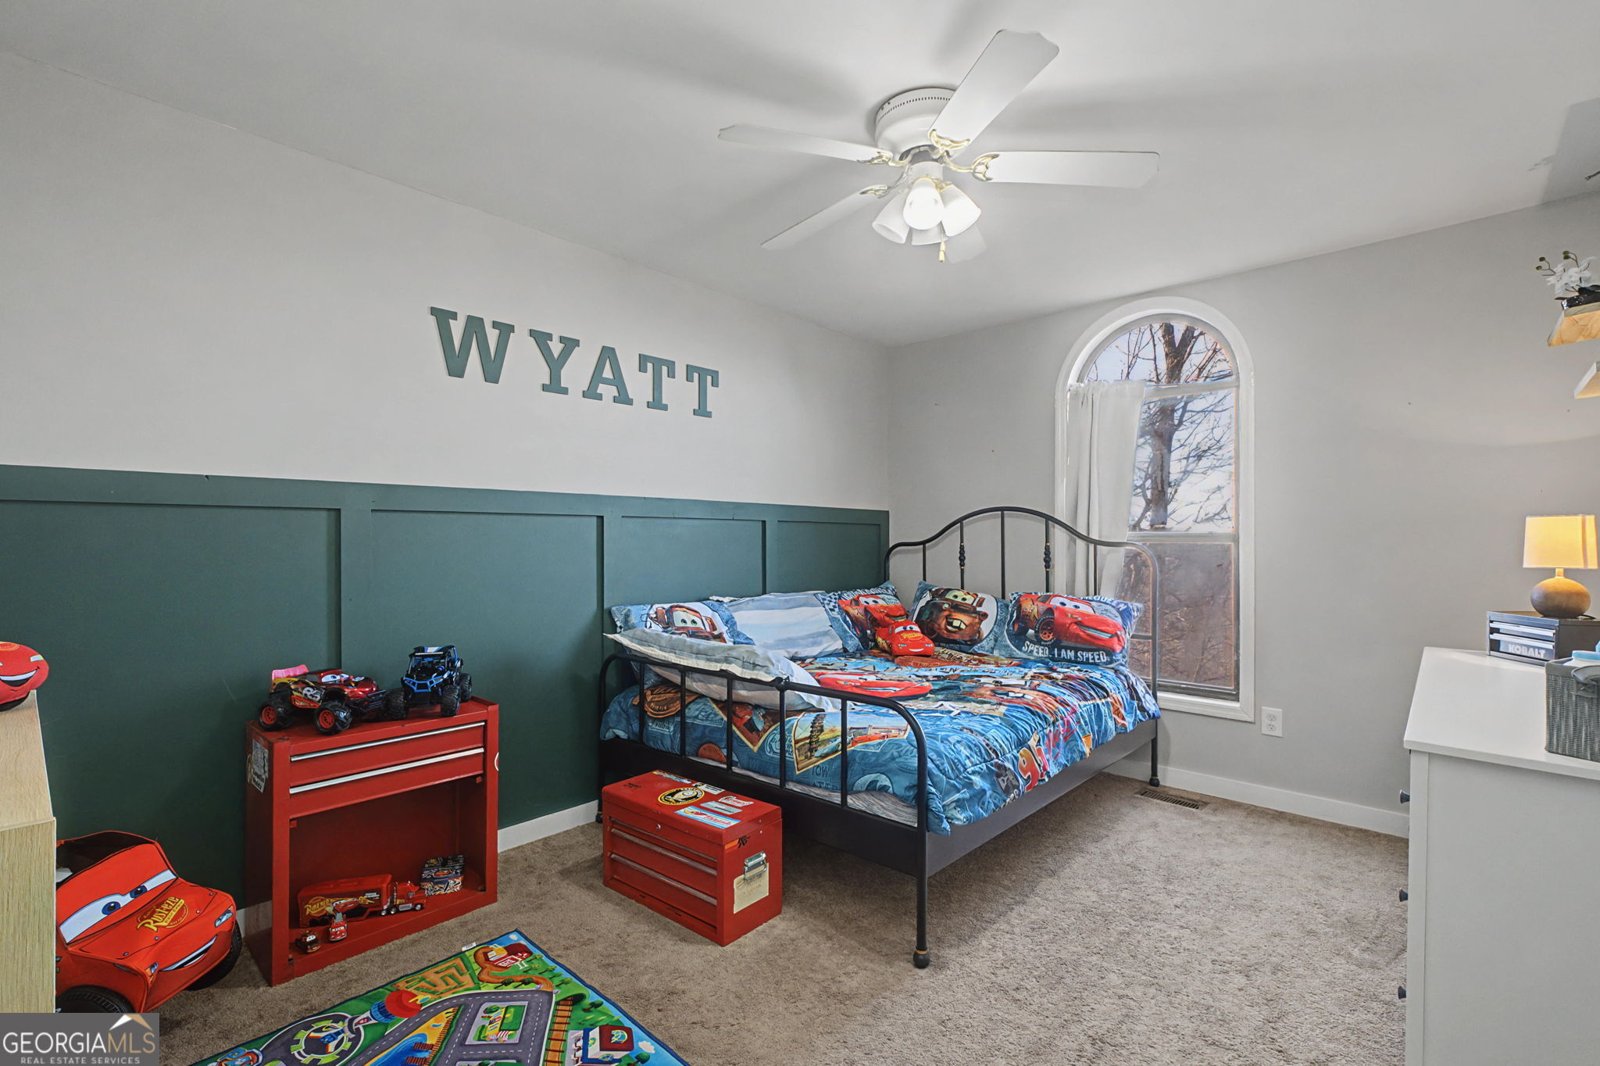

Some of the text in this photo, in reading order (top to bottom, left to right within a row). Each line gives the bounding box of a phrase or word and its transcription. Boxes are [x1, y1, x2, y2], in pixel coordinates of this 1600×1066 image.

[430, 306, 720, 419] WYATT
[1022, 641, 1052, 657] SPEED.
[1060, 649, 1075, 660] AM
[1508, 644, 1546, 659] KOBALT
